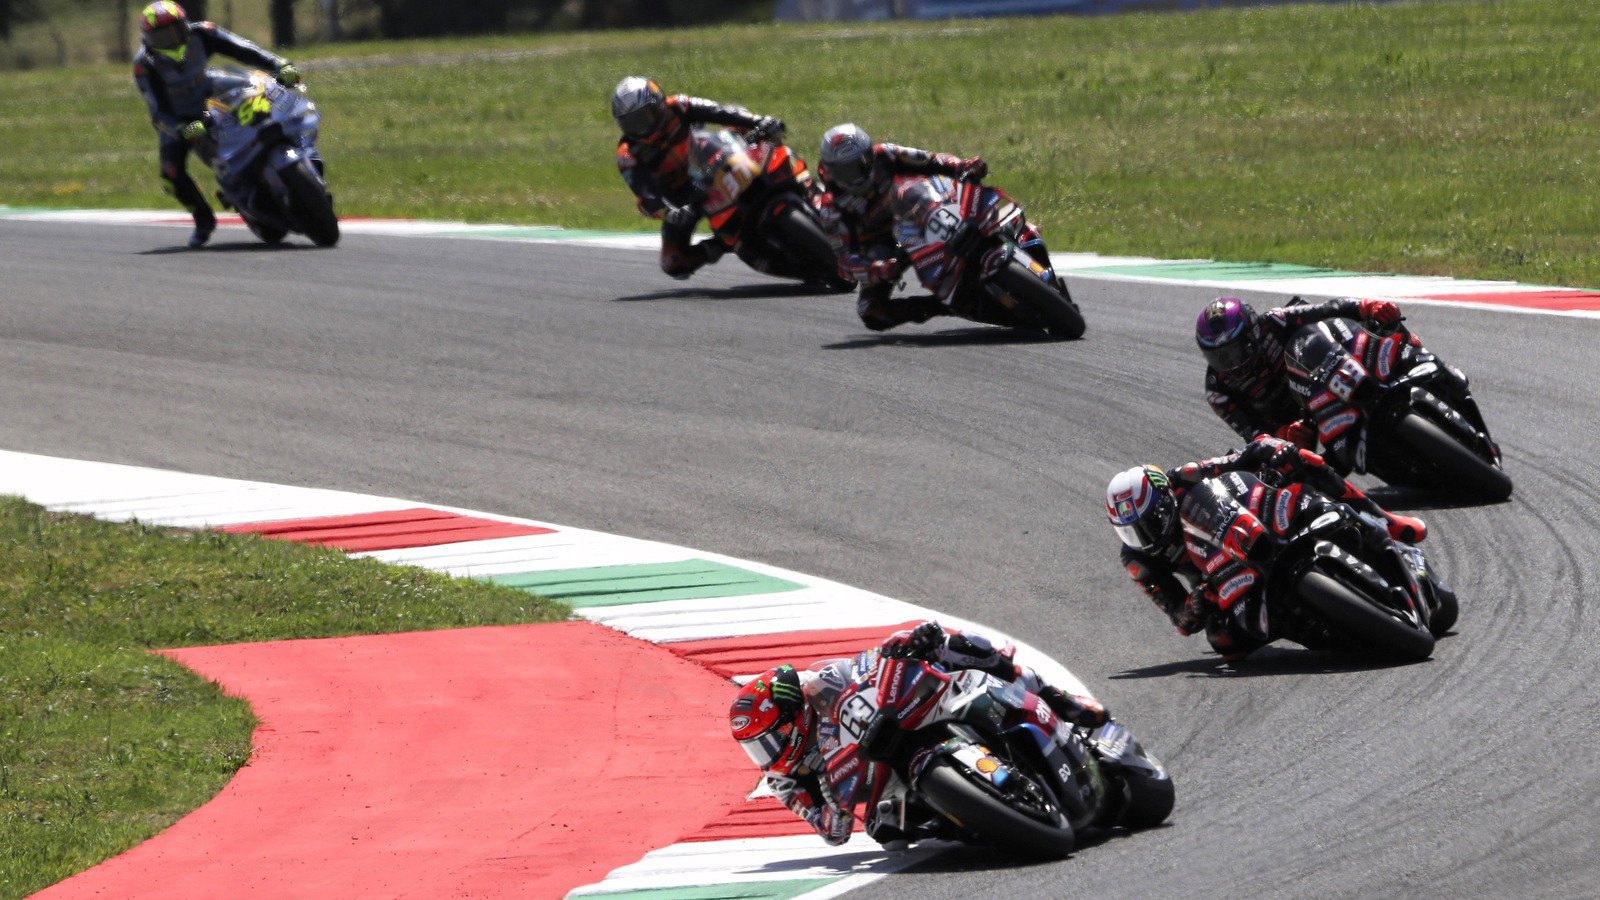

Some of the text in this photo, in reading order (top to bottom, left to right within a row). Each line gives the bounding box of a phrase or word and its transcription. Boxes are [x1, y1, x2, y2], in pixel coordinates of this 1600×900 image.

[928, 208, 960, 242] 93
[886, 661, 904, 704] Lenovo
[839, 694, 876, 743] 63
[829, 756, 859, 784] Lenovo
